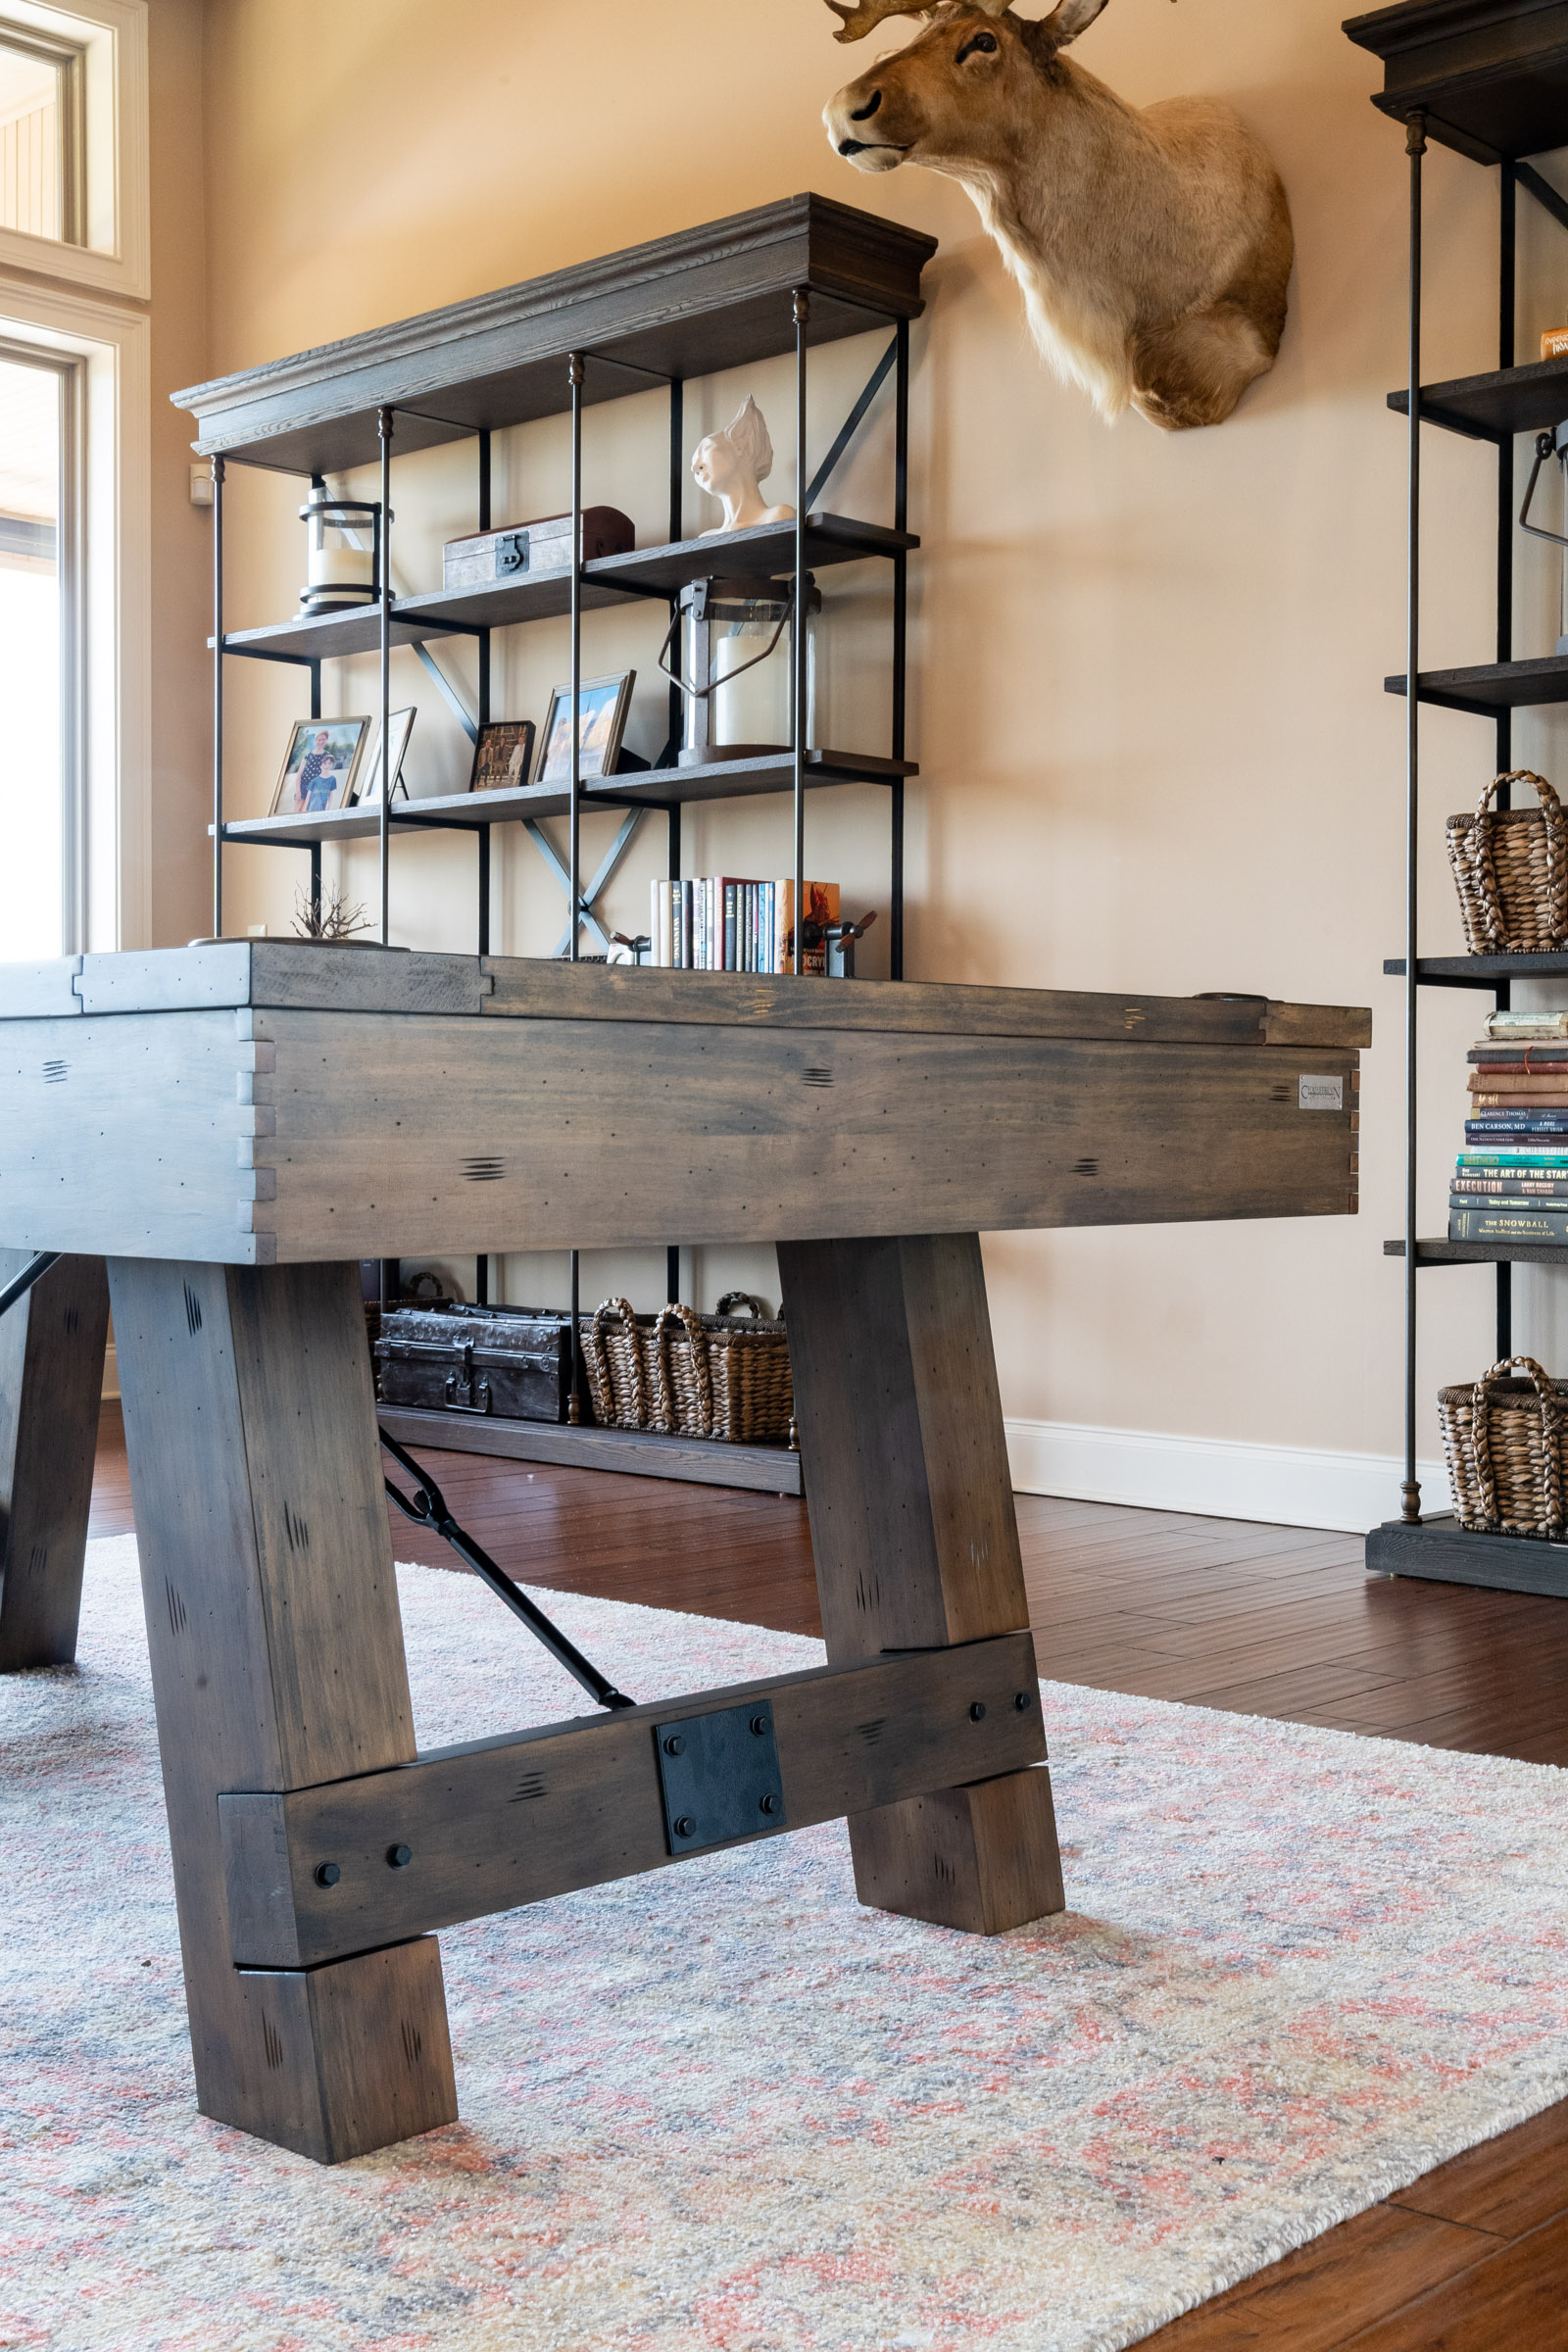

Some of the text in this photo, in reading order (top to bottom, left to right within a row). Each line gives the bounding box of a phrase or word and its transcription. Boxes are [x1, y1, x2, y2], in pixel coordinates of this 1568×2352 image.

[1463, 1155, 1499, 1165] SHINGO
[1484, 1168, 1498, 1177] THE
[1499, 1169, 1515, 1178] ART
[1517, 1169, 1528, 1178] OF
[1529, 1169, 1544, 1179] THE
[1455, 1180, 1502, 1193] EXECUTION
[1498, 1219, 1549, 1229] SNOWBALL
